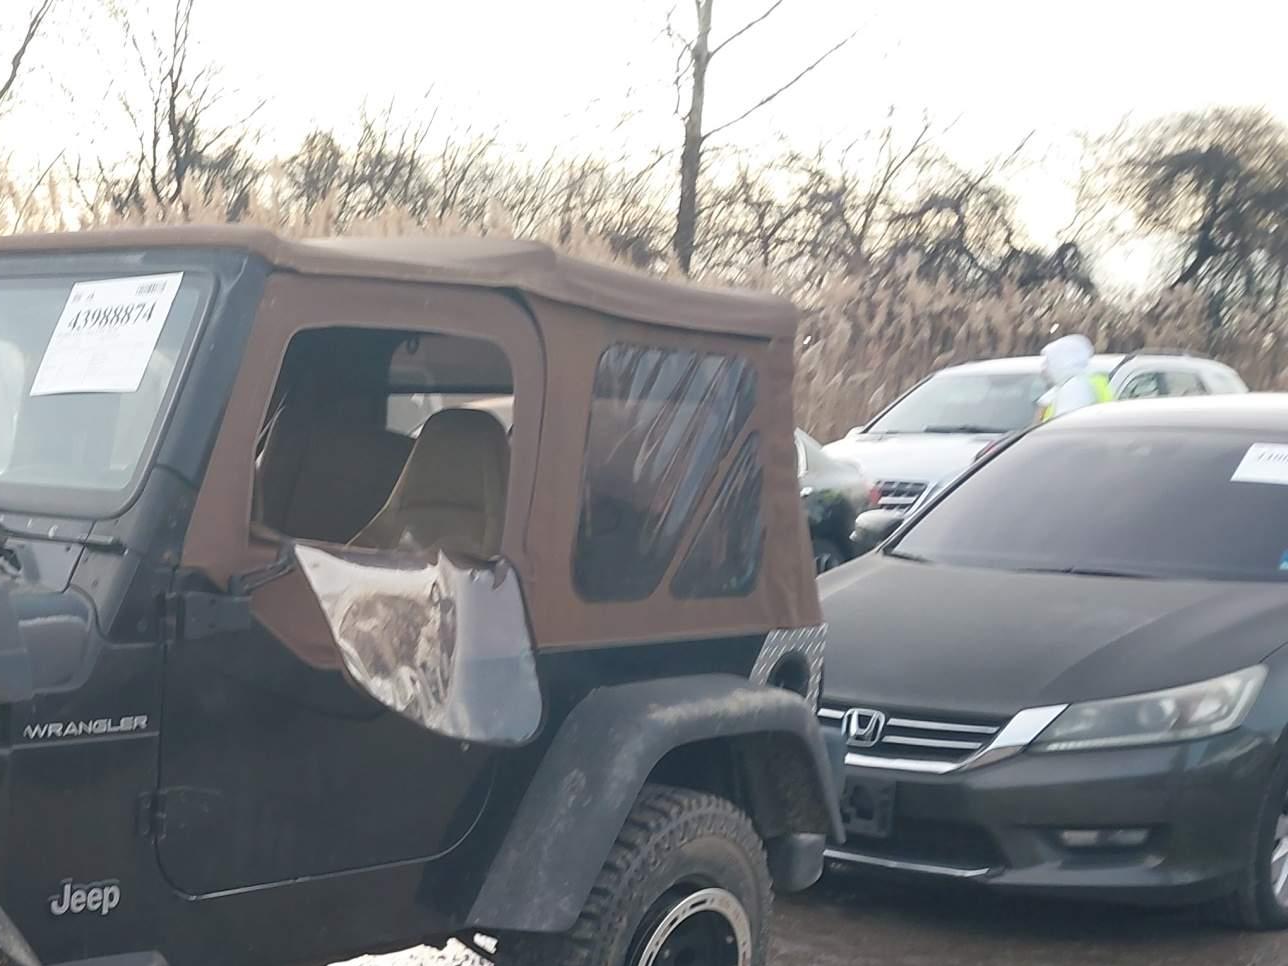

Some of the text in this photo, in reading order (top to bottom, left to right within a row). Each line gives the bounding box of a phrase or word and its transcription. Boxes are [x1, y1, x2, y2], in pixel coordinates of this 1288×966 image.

[67, 300, 158, 331] 43988874
[23, 715, 148, 739] WRANGLER
[50, 881, 121, 915] Jeep
